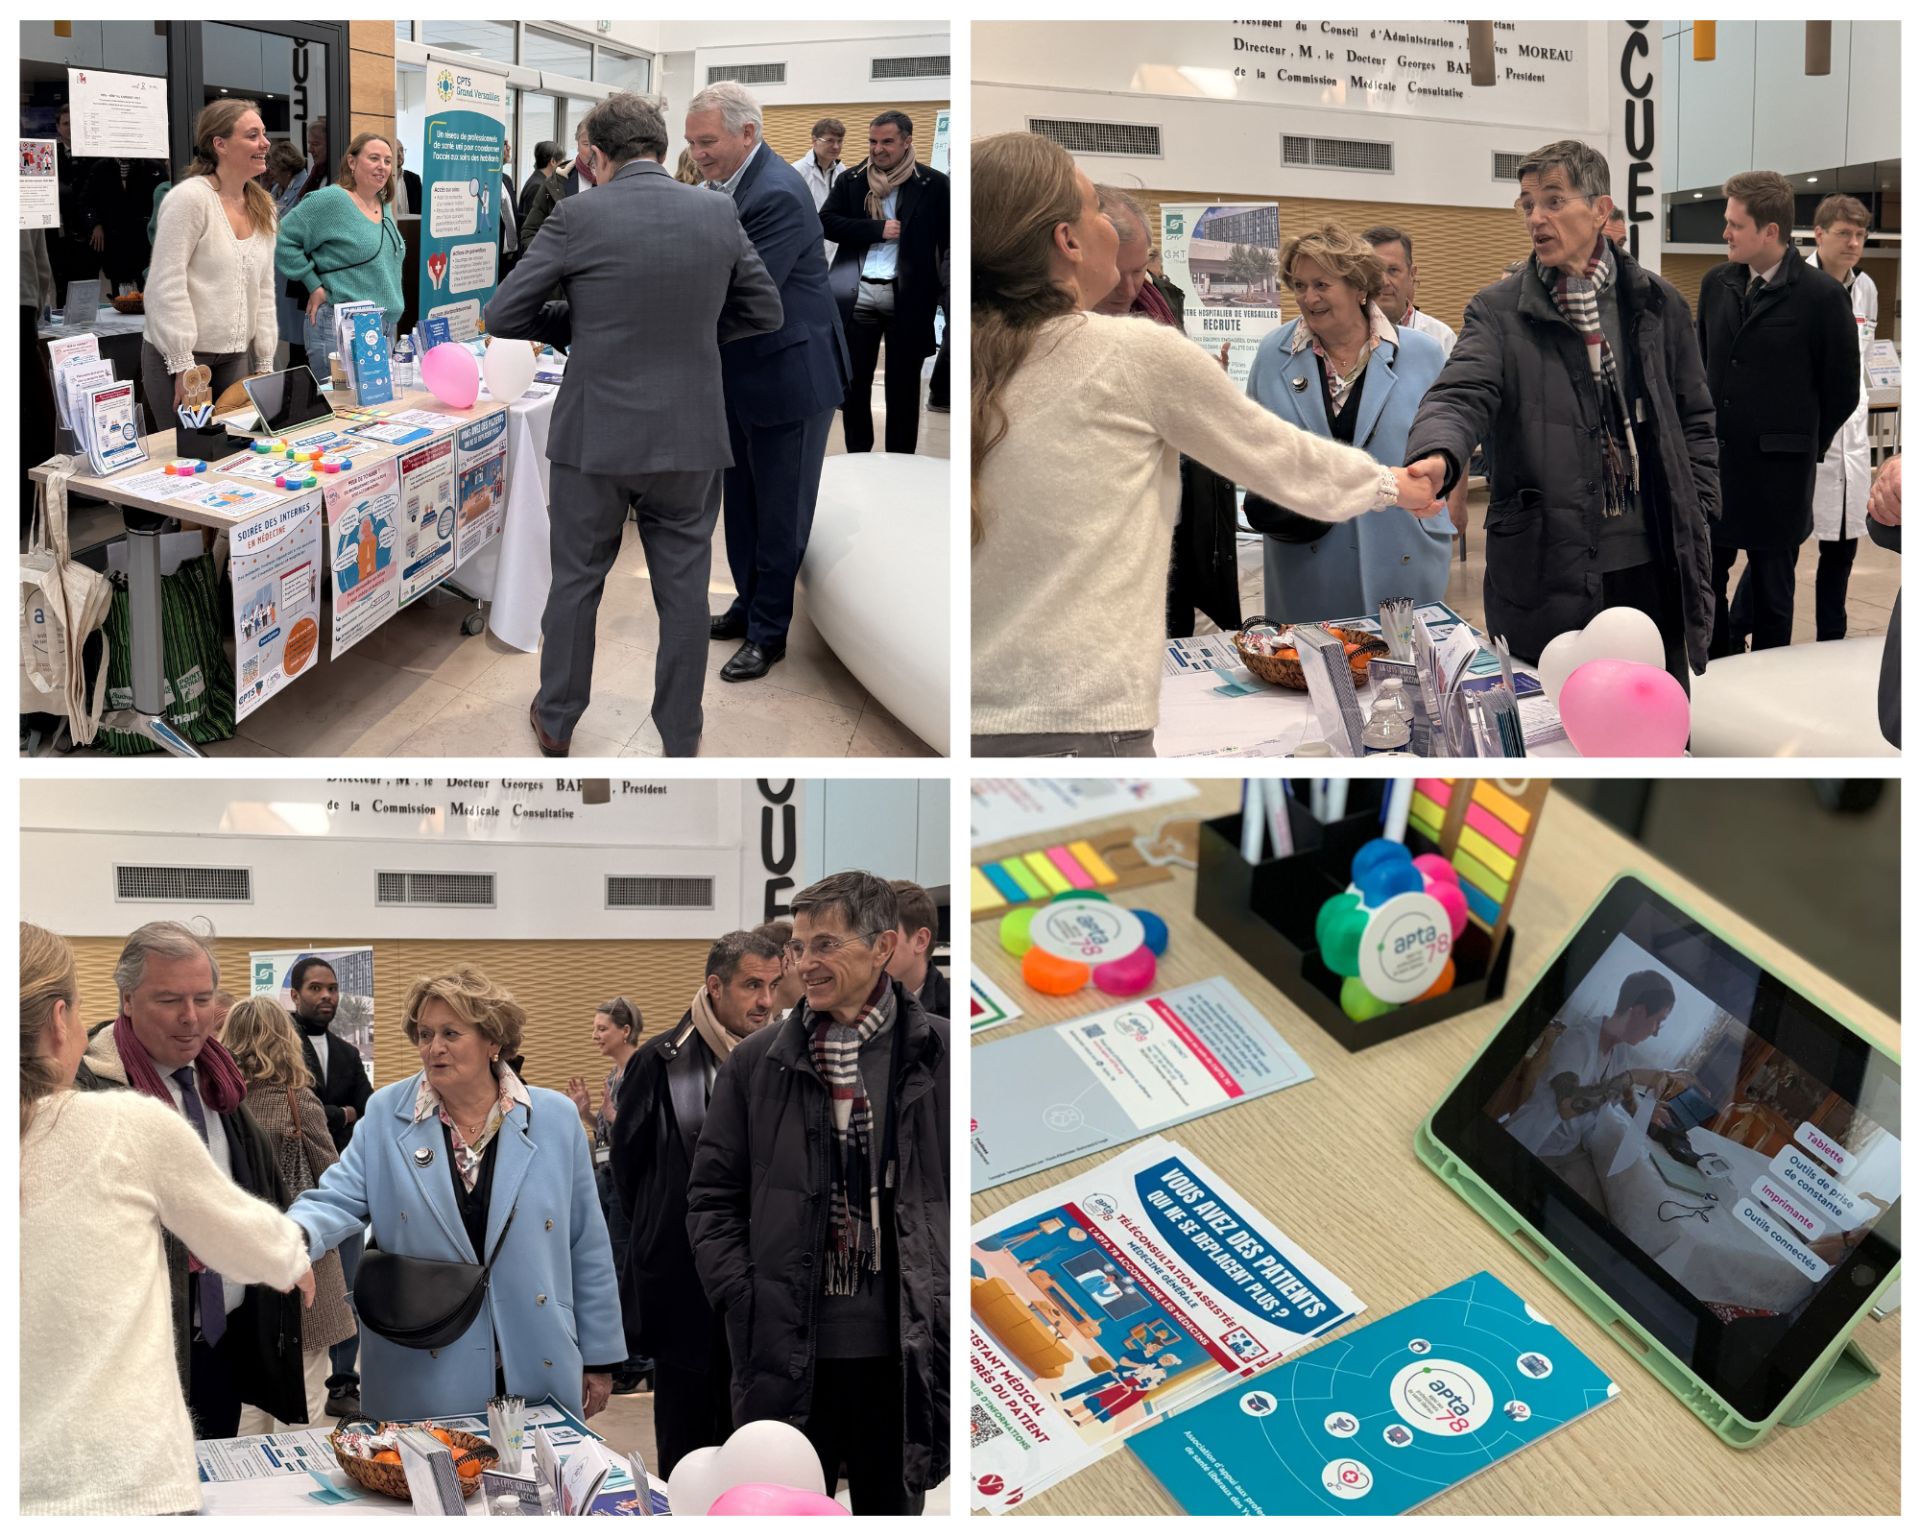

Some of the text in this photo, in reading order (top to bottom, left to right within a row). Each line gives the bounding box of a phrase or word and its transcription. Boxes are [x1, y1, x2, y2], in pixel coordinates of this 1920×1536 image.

[1296, 21, 1307, 32] du
[1321, 21, 1359, 37] Conseil
[1518, 44, 1573, 62] MOREAU
[1326, 49, 1335, 60] le
[1346, 49, 1387, 66] Docteur
[1397, 55, 1436, 71] Georges
[1447, 60, 1472, 75] BAR
[456, 75, 471, 87] CPTS
[457, 87, 474, 97] Grand
[474, 90, 500, 102] Versailles
[1234, 67, 1246, 77] de
[1256, 69, 1266, 79] la
[1277, 69, 1337, 87] Commission
[1407, 81, 1464, 98] Consultative
[433, 141, 441, 149] de
[1199, 309, 1232, 318] HOSPITALIER
[1244, 310, 1278, 319] VERSAILLES
[1203, 318, 1241, 331] RECRUTE
[238, 502, 310, 542] SOIRÉE DES INTERNES
[247, 525, 286, 549] EN MÉDECINE
[180, 671, 201, 684] POINT
[239, 687, 256, 705] CPTS
[501, 778, 544, 791] Georges
[556, 779, 583, 792] BAR
[327, 800, 339, 810] de
[351, 801, 360, 812] la
[372, 799, 436, 815] Commission
[513, 804, 574, 819] Consultative
[1394, 925, 1437, 954] apta
[1425, 933, 1451, 964] 78
[1806, 1131, 1845, 1164] Tablette
[1784, 1167, 1843, 1217] de constante
[1789, 1155, 1854, 1210] Outils de prise
[1094, 1198, 1115, 1215] apta
[1097, 1212, 1114, 1222] 78
[1761, 1183, 1815, 1230] Imprimante
[1147, 1190, 1290, 1321] QUI NE SE DEPLACENT PLUS ?
[1160, 1168, 1328, 1320] VOUS AVEZ DES PATIENTS
[1743, 1207, 1817, 1272] Outils connectés
[1088, 1226, 1210, 1347] L'APTA 78 ACCOMPAGNE LES MÉDECINS
[1116, 1214, 1237, 1329] TÉLÉCONSULTATION ASSISTÉE
[1127, 1240, 1199, 1309] MÉDECINE GÉNÉRALE
[1003, 1368, 1047, 1417] MÉDICAL
[1428, 1379, 1470, 1417] apta
[981, 1396, 1032, 1452] D'INFORMATIONS
[991, 1383, 1011, 1400] DU
[1005, 1397, 1050, 1444] PATIENT
[1436, 1408, 1470, 1433] 78
[1184, 1430, 1247, 1498] Association d'appui aux
[1185, 1446, 1242, 1509] de santé libéraux des
